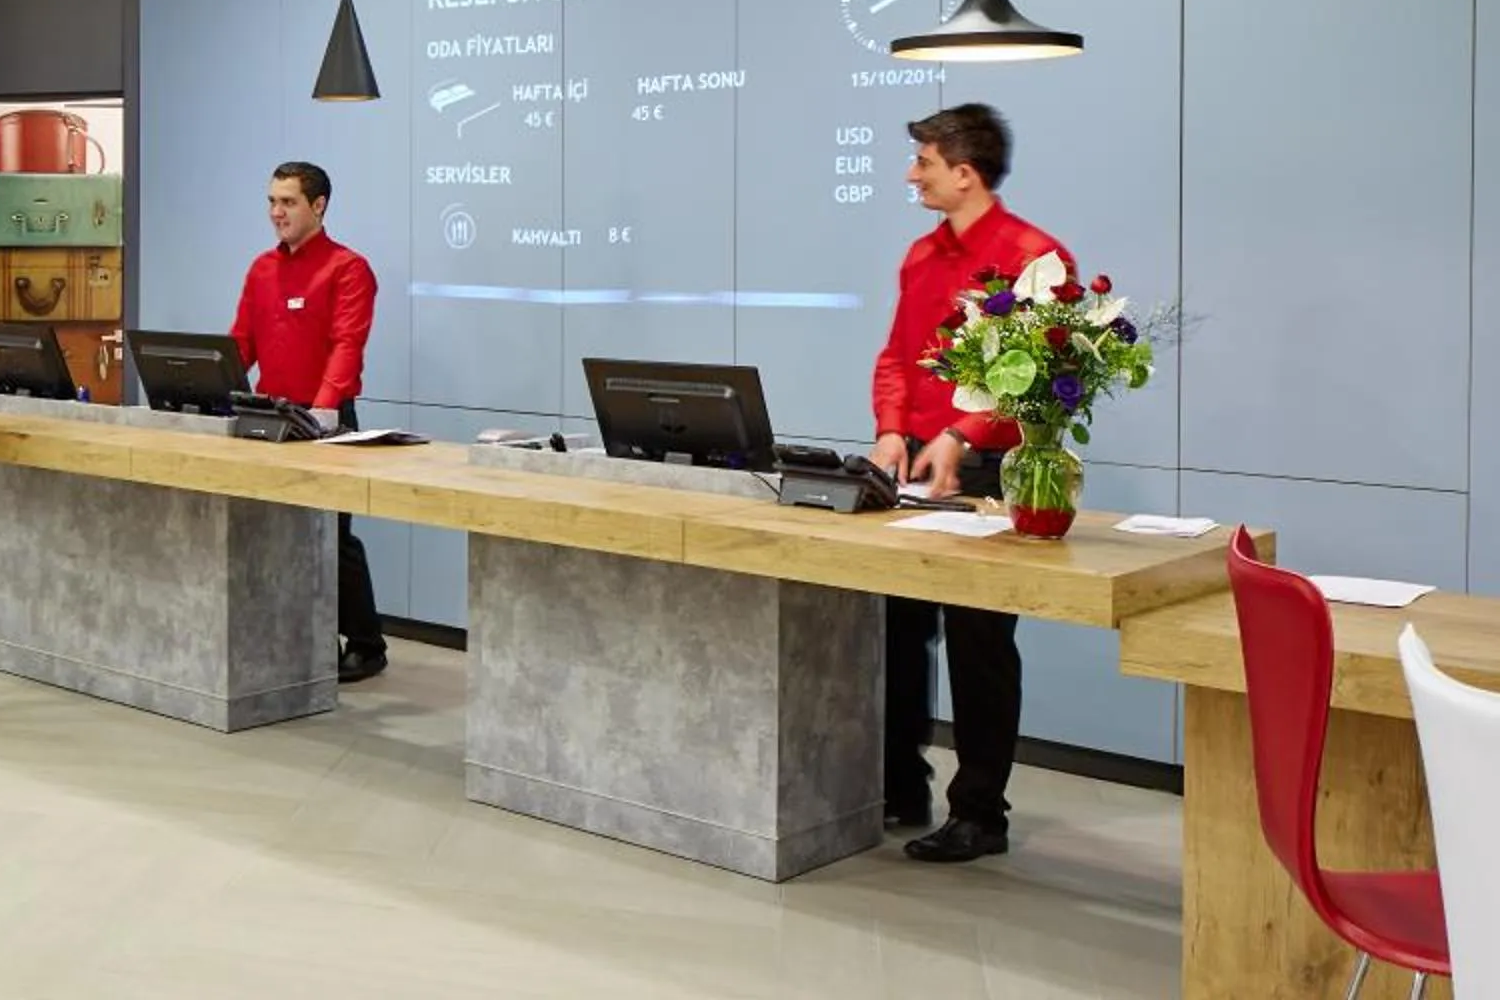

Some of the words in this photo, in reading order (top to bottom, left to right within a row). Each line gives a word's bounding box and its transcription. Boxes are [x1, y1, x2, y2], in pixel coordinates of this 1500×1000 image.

[427, 40, 461, 59] ODA
[466, 33, 553, 57] FİYATLARI
[637, 74, 694, 94] HAFTA
[698, 70, 746, 90] SONU
[851, 67, 946, 87] 15/10/2014
[512, 83, 564, 101] HAFTA
[836, 127, 873, 145] USD
[426, 162, 512, 184] SERVİSLER
[835, 155, 873, 174] EUR
[835, 184, 873, 203] GBP
[512, 228, 582, 246] KAHVALTI
